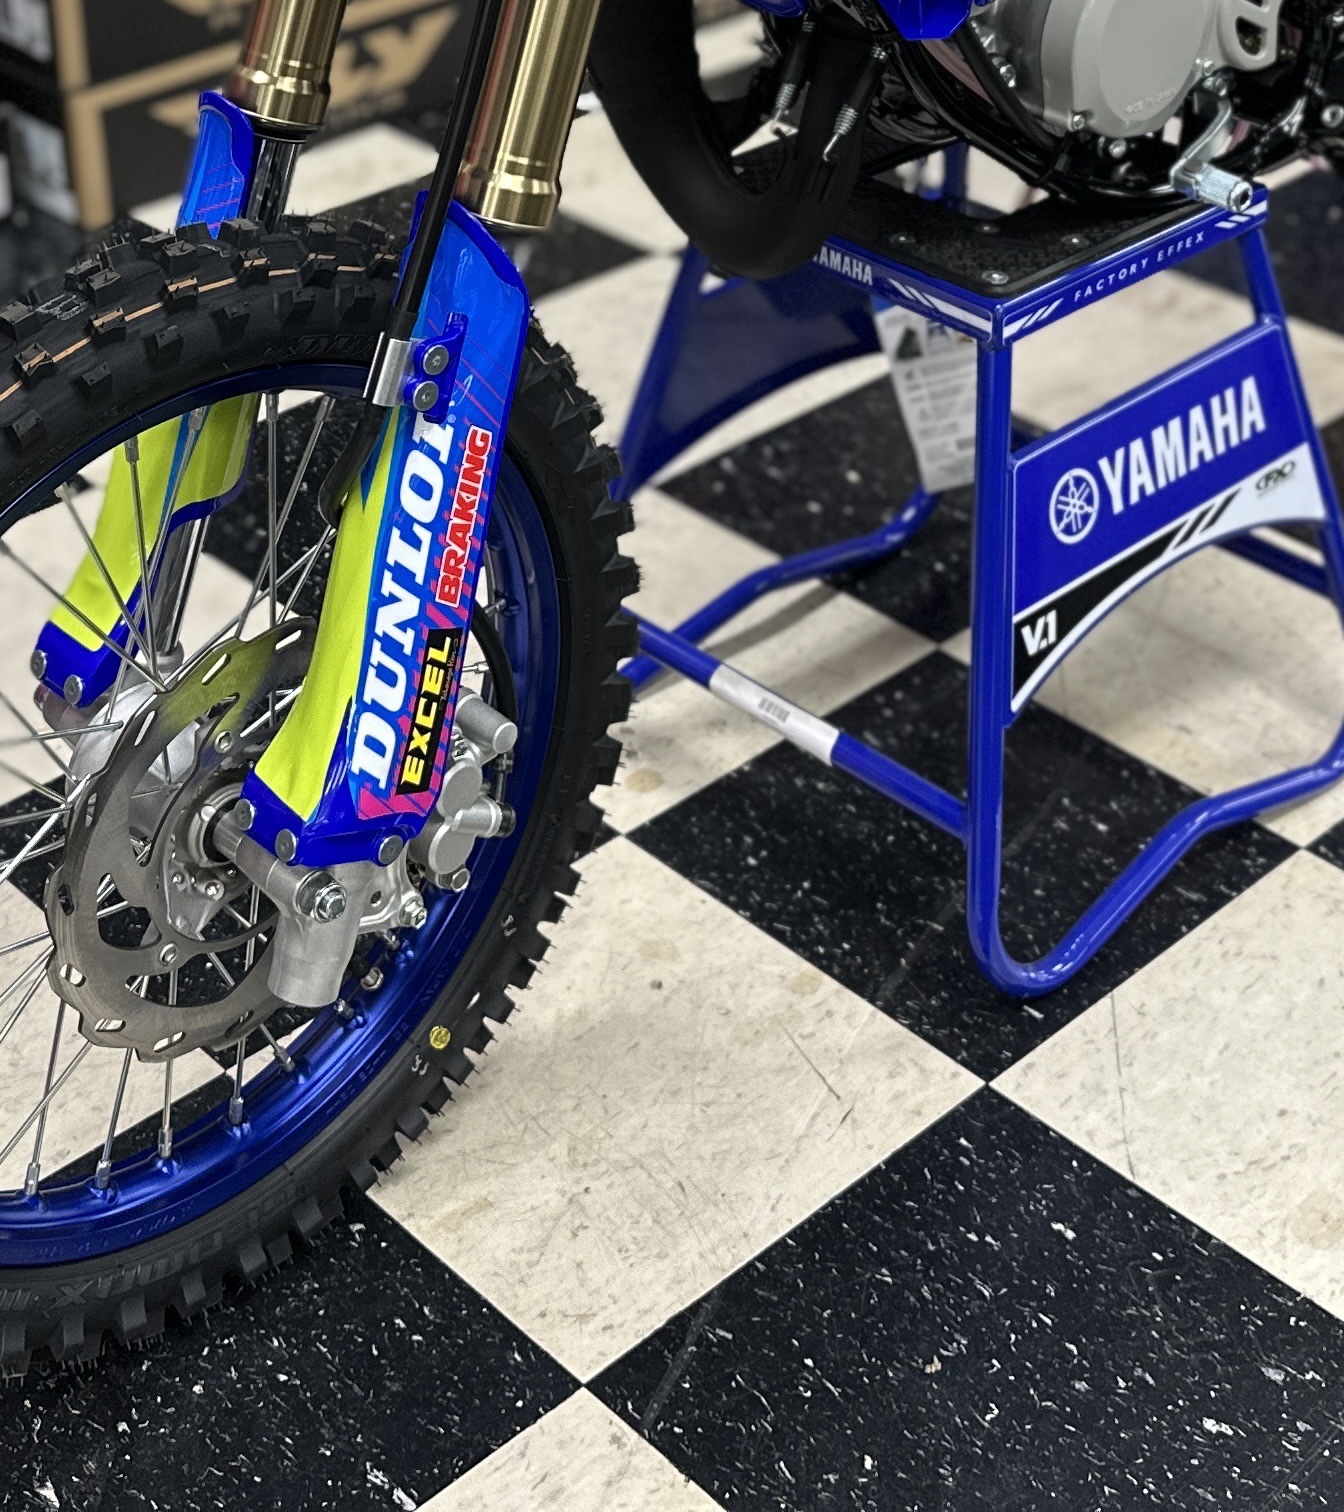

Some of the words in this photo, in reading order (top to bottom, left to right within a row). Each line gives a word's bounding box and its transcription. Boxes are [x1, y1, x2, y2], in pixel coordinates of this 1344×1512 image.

[812, 245, 874, 286] AMAHA
[1074, 257, 1149, 303] FACTORY
[1157, 231, 1205, 263] EFFEX
[436, 424, 493, 608] BRAKING
[1097, 375, 1268, 517] YAMAHA
[400, 636, 452, 786] EXCEL
